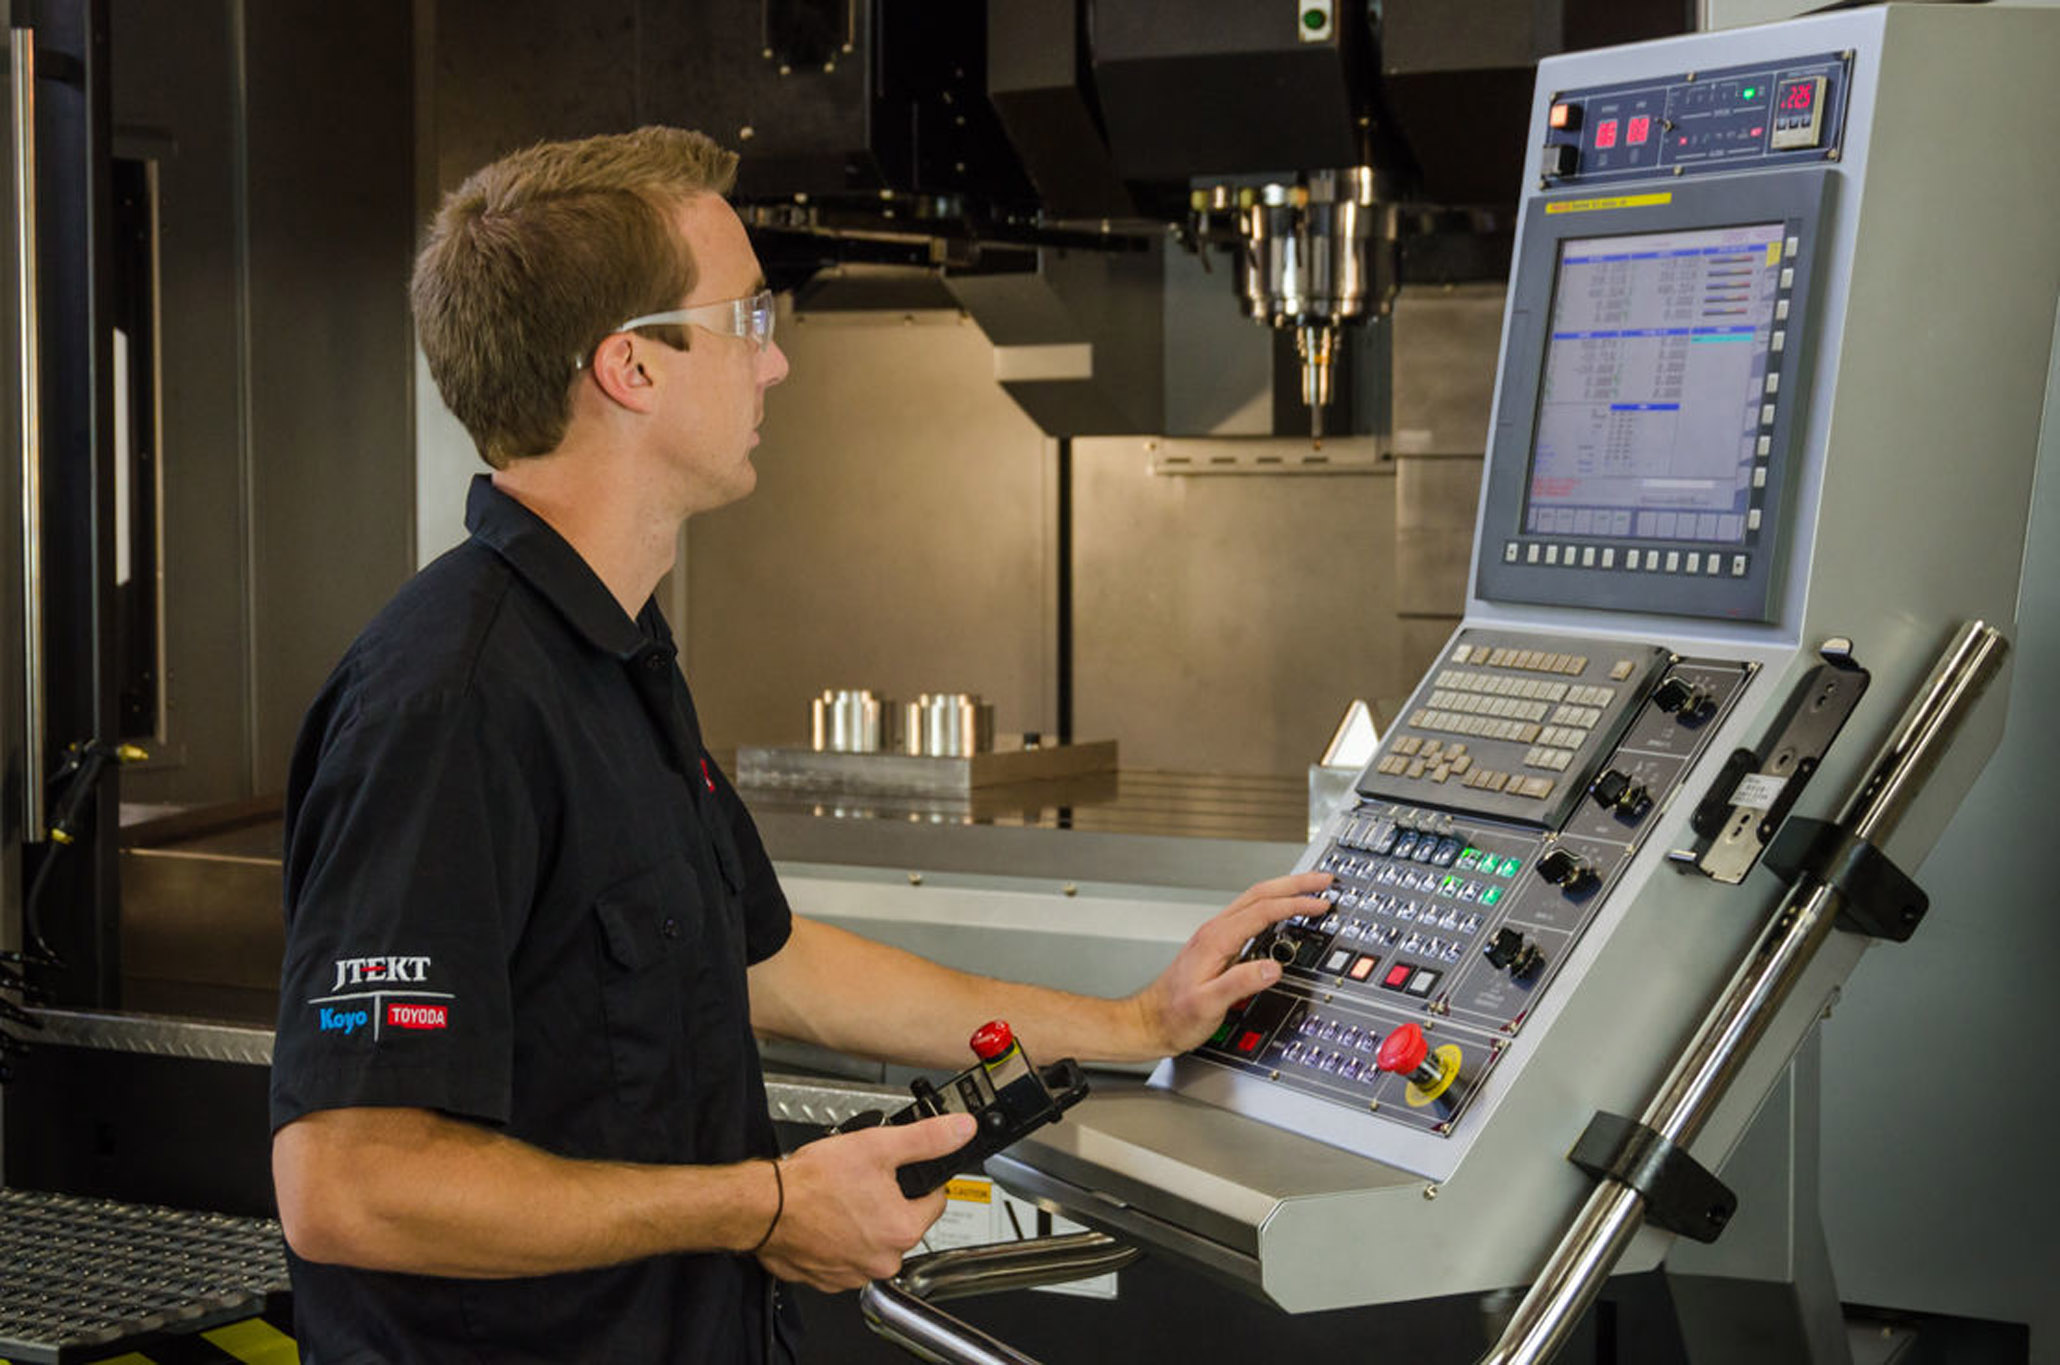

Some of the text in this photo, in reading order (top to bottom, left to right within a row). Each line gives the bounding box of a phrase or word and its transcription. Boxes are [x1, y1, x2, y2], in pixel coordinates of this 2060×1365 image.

[332, 957, 431, 991] JTEKT
[320, 1008, 368, 1035] Koyo
[391, 1008, 446, 1025] TOYODA
